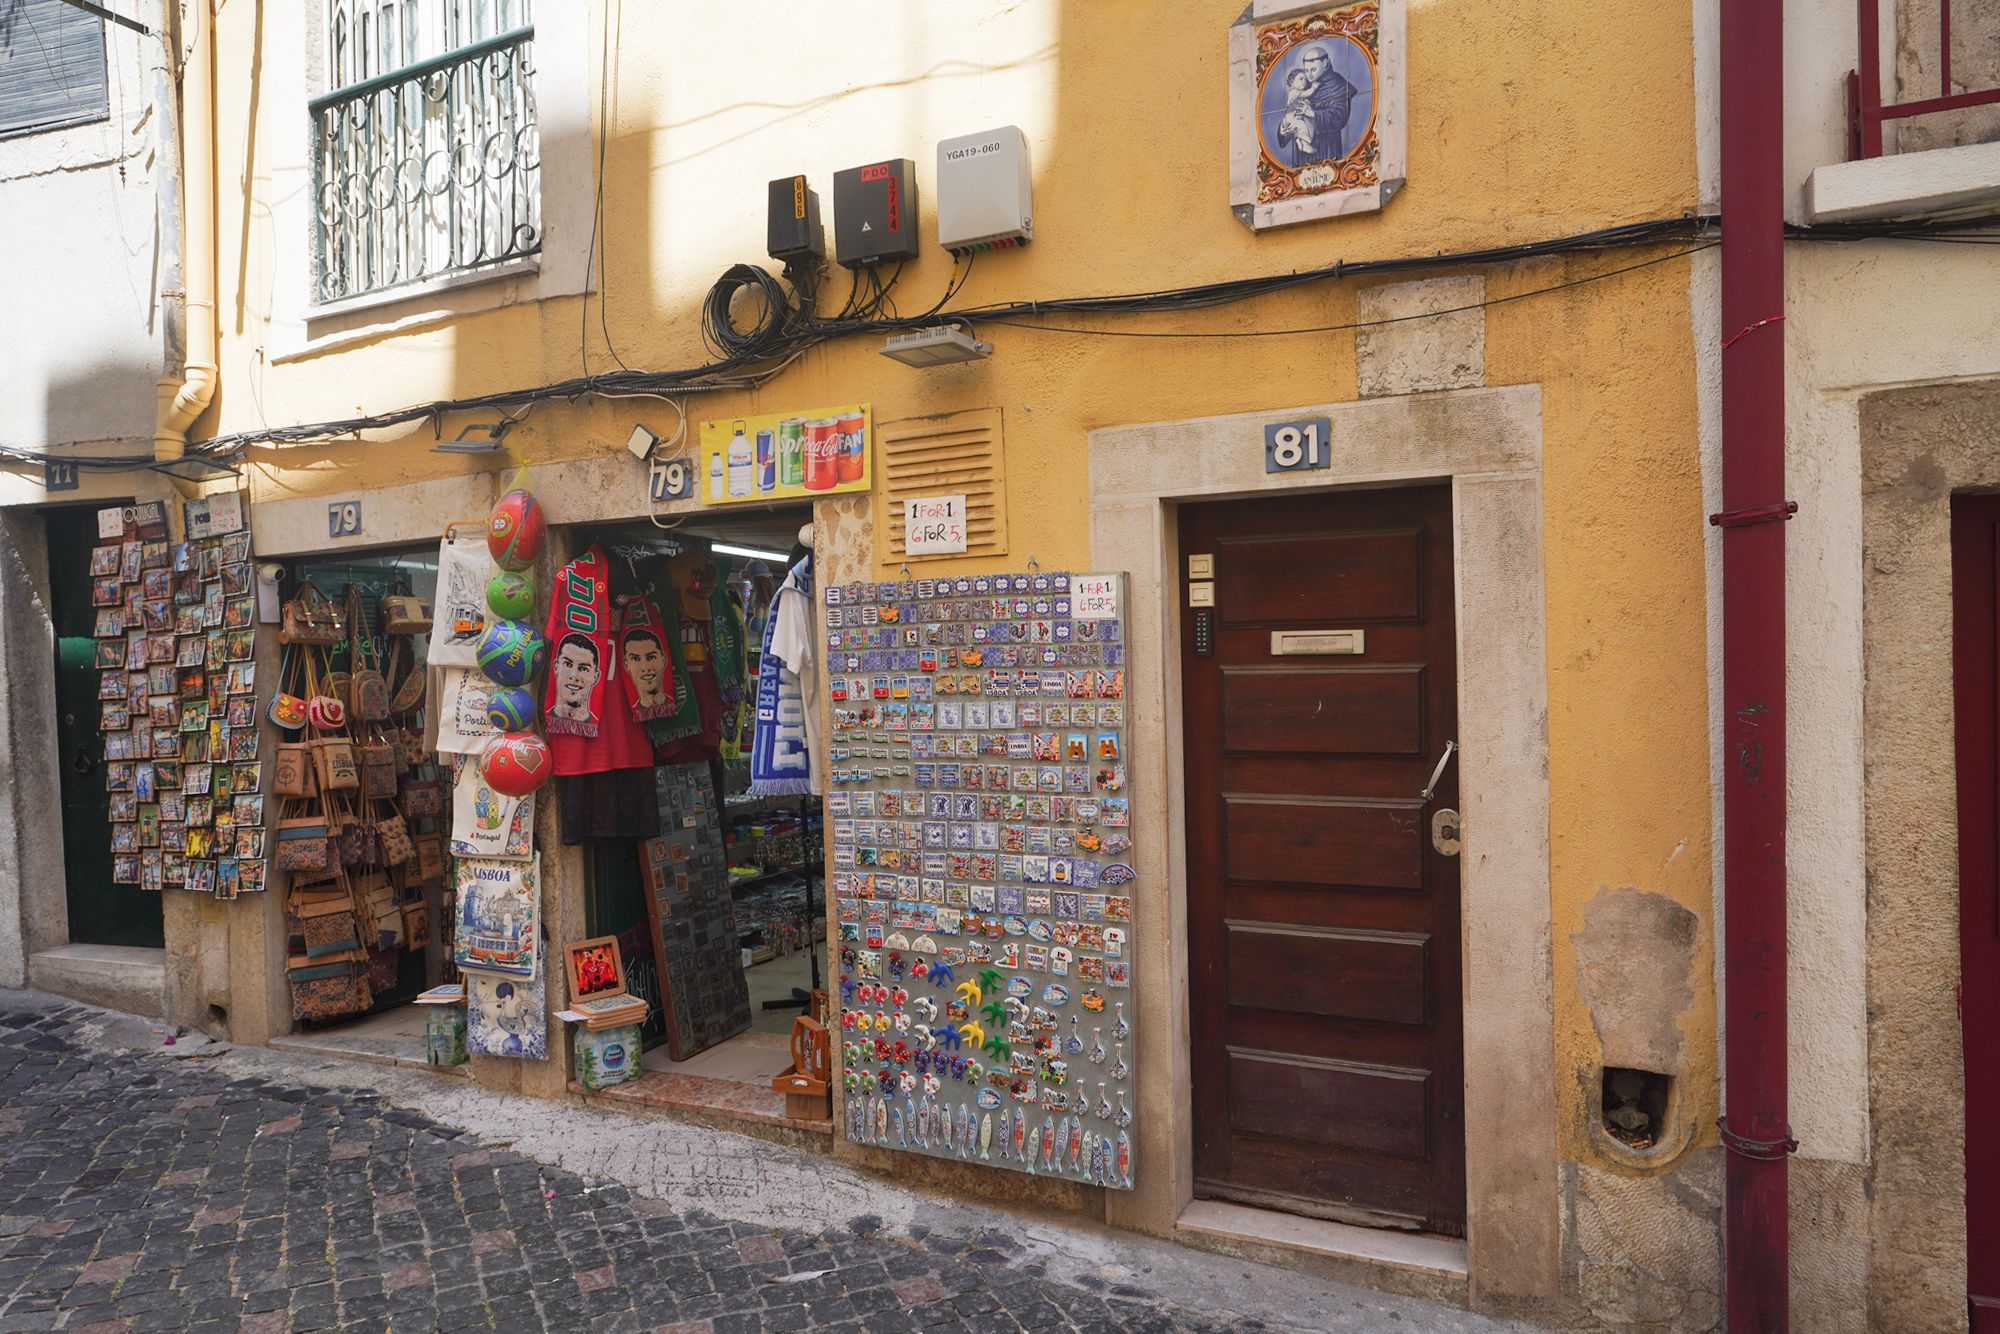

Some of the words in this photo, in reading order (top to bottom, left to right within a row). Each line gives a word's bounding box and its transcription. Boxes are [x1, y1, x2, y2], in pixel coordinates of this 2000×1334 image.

[946, 142, 1000, 160] YGA19-060
[863, 166, 887, 178] PDO
[1274, 424, 1318, 466] 81
[650, 463, 684, 498] 79
[122, 503, 160, 523] ORTUGAL
[329, 504, 357, 533] 79
[506, 628, 534, 668] PORTUGAL
[473, 867, 511, 882] LISBOA
